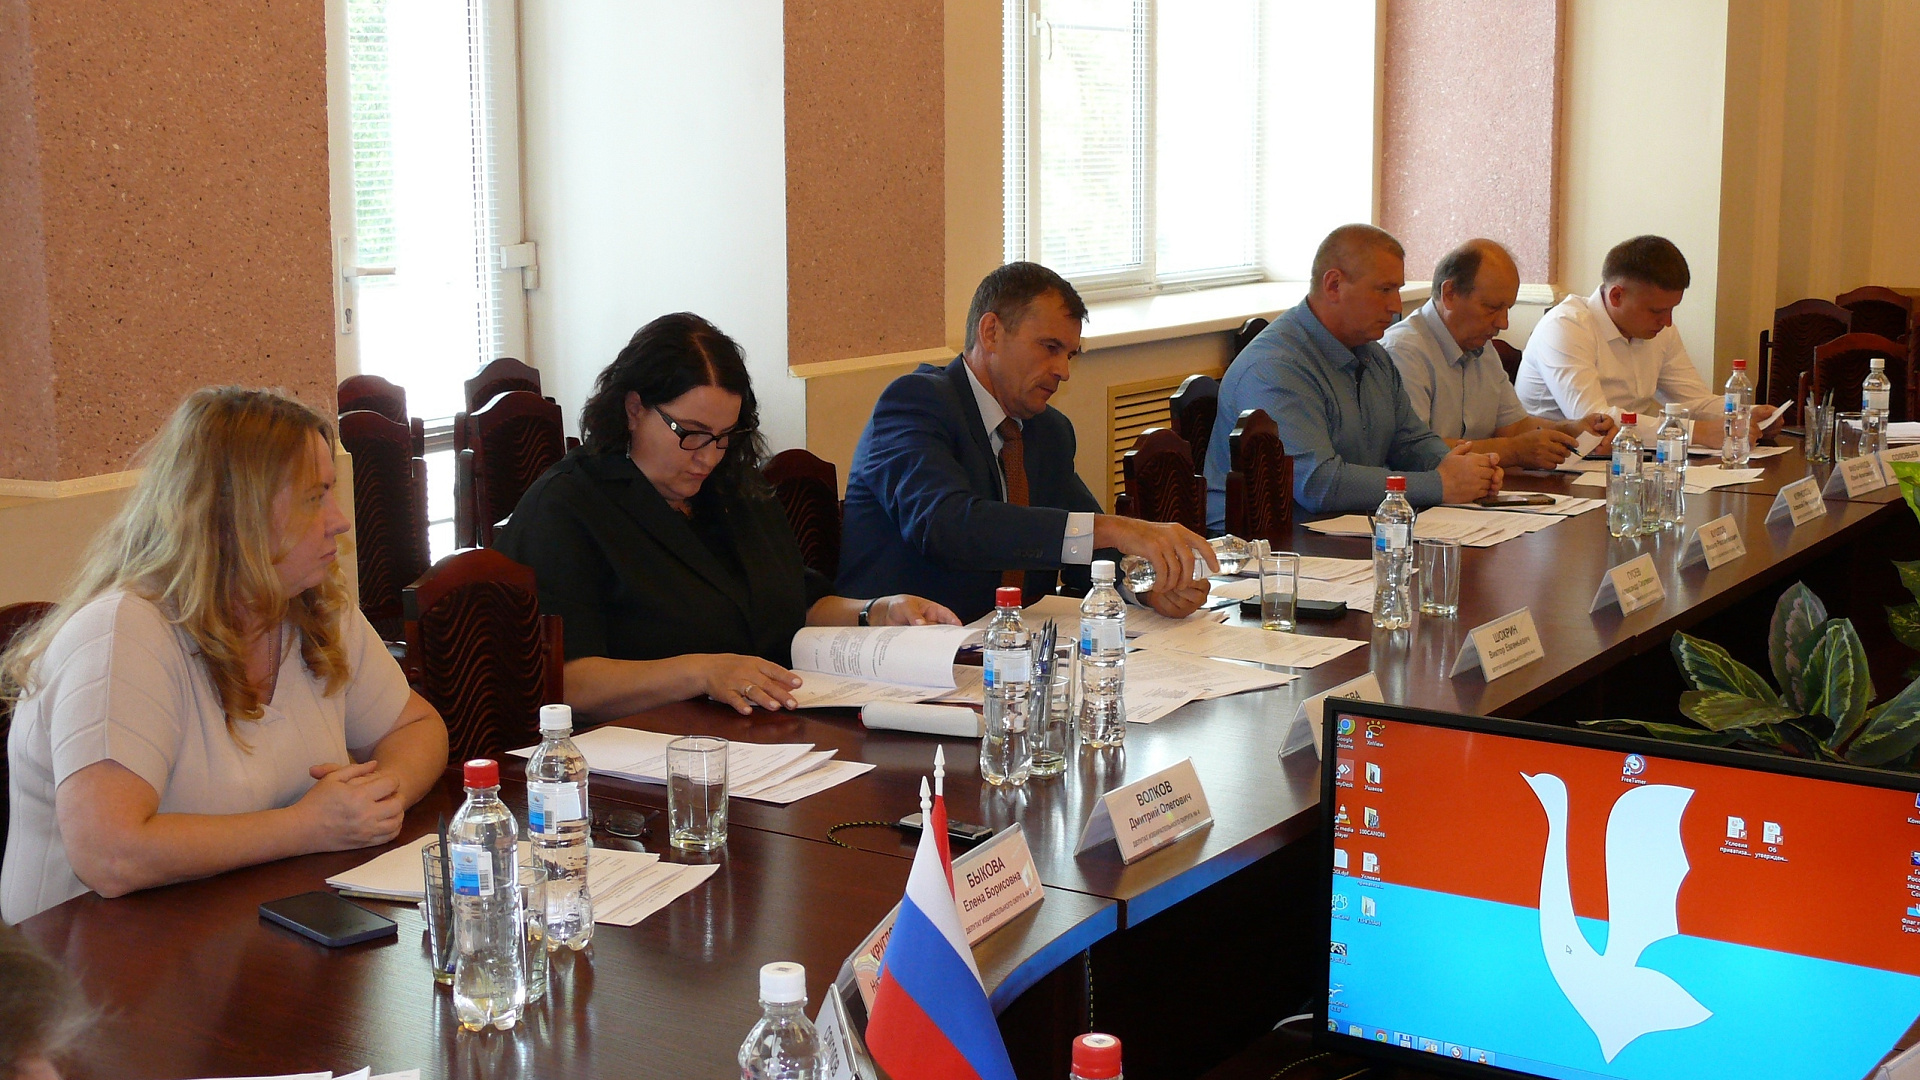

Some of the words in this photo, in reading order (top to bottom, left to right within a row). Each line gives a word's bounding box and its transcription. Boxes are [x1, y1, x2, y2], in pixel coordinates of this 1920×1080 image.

[1492, 624, 1518, 643] ШОХРИН
[1136, 780, 1173, 806] ВОЛКОВ
[1620, 776, 1647, 785] FreeTimer
[1129, 806, 1160, 831] Дмитрий
[1159, 793, 1192, 814] Олегович
[966, 856, 1006, 888] БЫКОВА
[963, 892, 986, 912] Елена
[984, 871, 1022, 897] Борисовна
